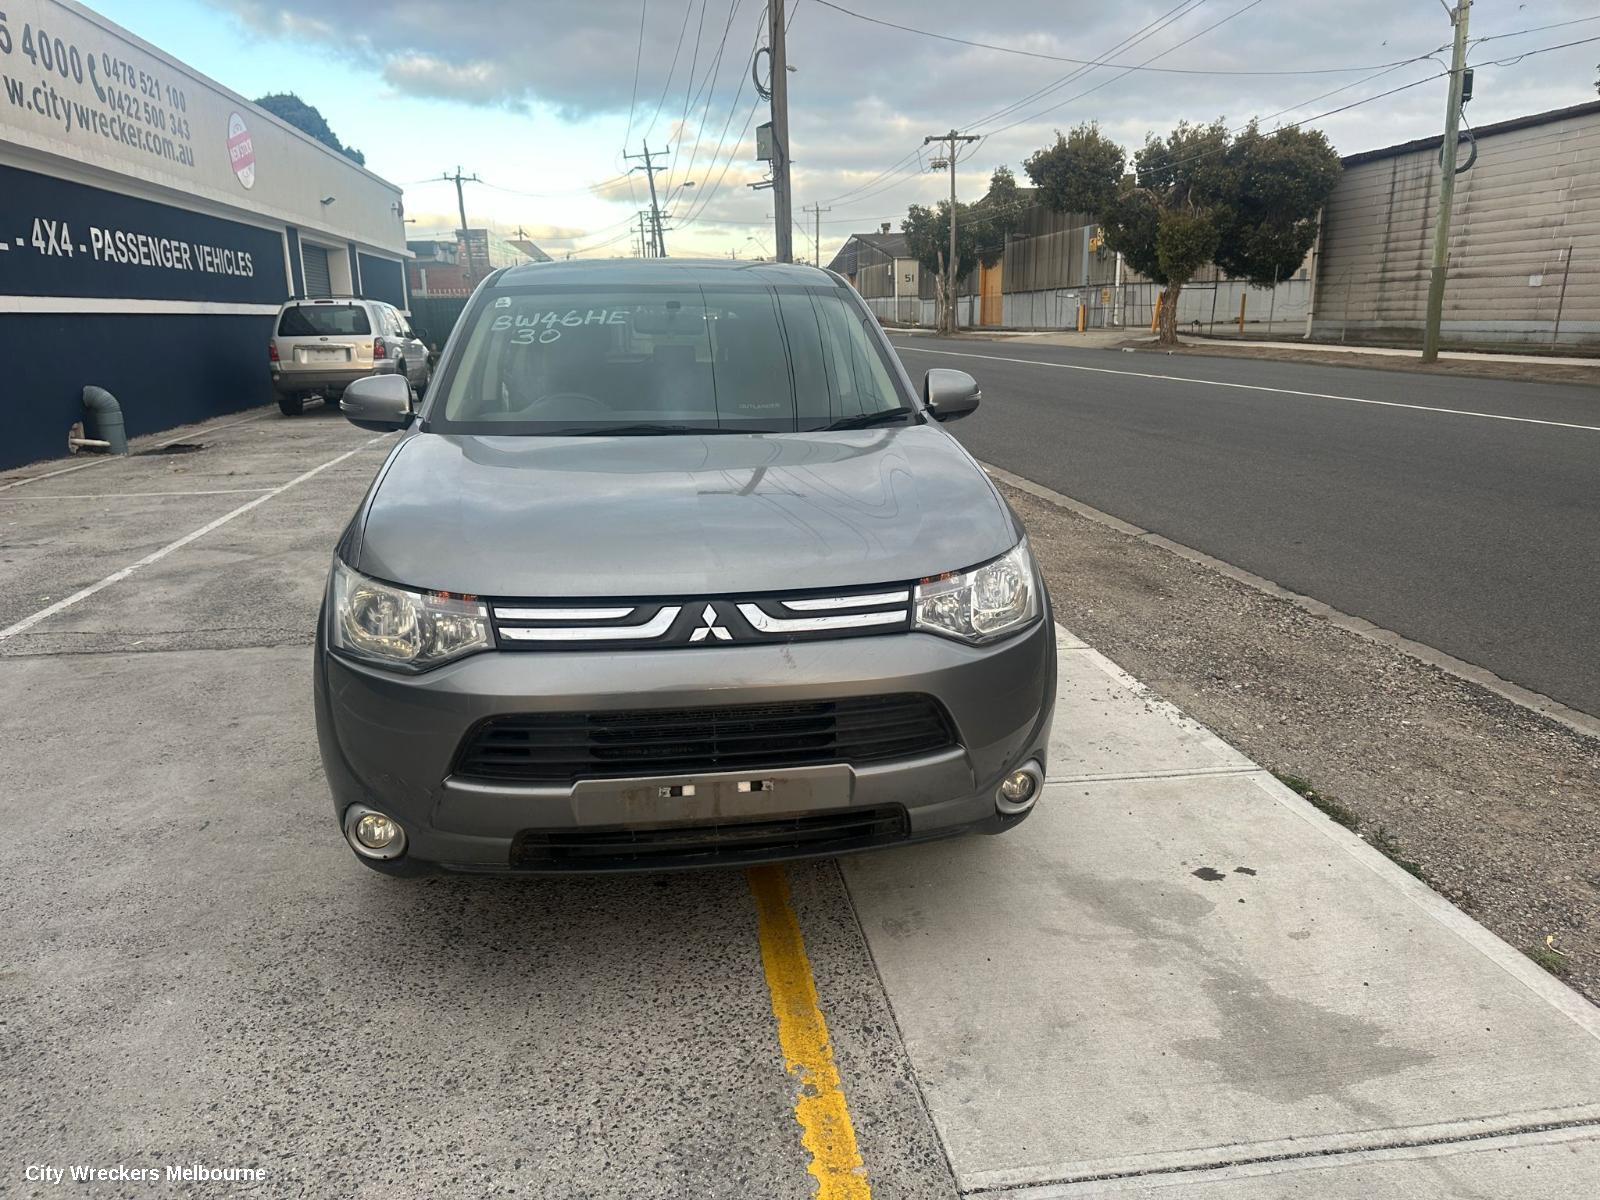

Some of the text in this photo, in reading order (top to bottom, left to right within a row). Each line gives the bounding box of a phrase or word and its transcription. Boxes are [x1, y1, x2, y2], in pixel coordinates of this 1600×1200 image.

[22, 24, 83, 84] 4000
[102, 52, 186, 113] 0478 521 100
[107, 86, 191, 140] 0422 500 343
[31, 218, 73, 257] 4X4
[90, 226, 193, 271] PASSENGER
[194, 244, 254, 277] VEHICLES
[904, 273, 915, 283] 51
[510, 328, 561, 345] 30
